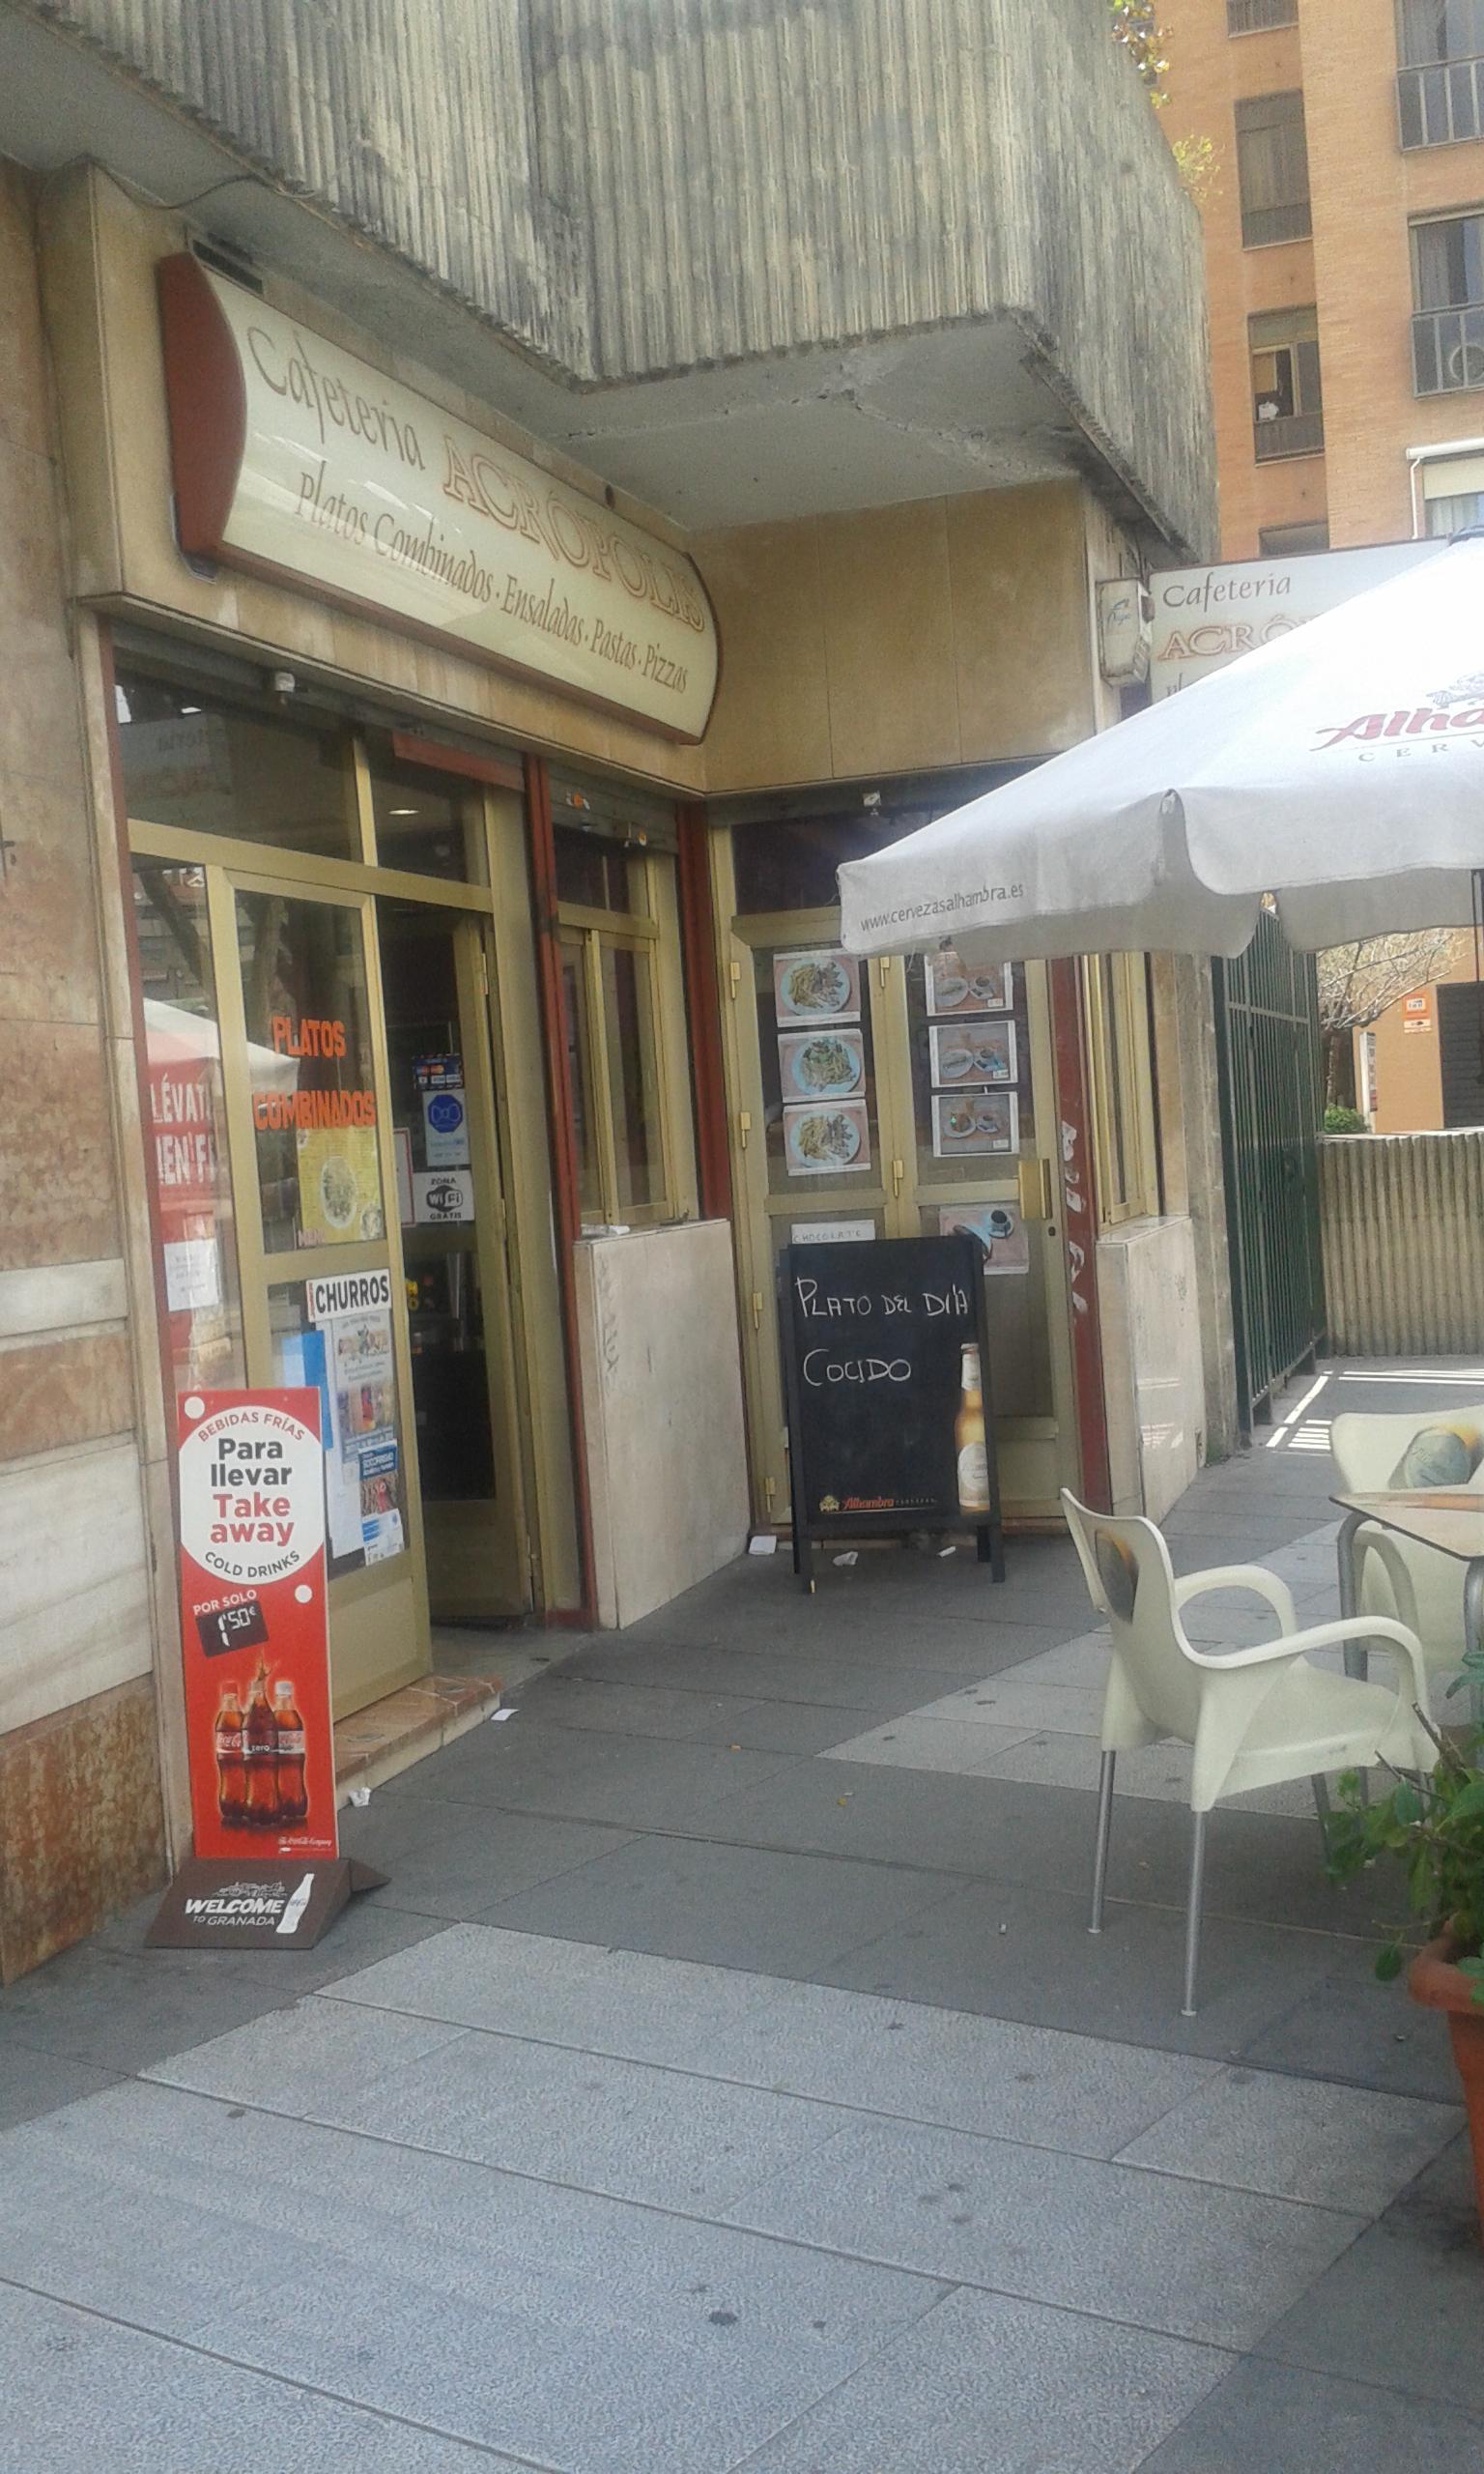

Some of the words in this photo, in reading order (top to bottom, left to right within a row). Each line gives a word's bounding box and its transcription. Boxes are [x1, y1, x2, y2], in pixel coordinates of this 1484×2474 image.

[295, 460, 369, 546] Platos
[374, 512, 495, 603] Combinados
[500, 574, 585, 646] Ensaladas
[590, 618, 638, 671] Pastas
[642, 643, 688, 694] Pizzas
[1157, 613, 1314, 661] ACRÓ
[860, 883, 1024, 932] www.cervezasalhambra.es
[272, 1016, 347, 1058] PLATOS
[253, 1089, 378, 1130] COMBINADOS
[316, 1275, 389, 1314] CHURROS
[795, 1276, 871, 1317] PLATO
[197, 1412, 260, 1442] BEBIDAS
[263, 1414, 305, 1441] FRÍAS
[218, 1438, 283, 1460] Para
[211, 1463, 293, 1487] llevar
[213, 1491, 291, 1518] Take
[210, 1522, 295, 1547] away
[205, 1551, 243, 1577] COLD
[247, 1550, 300, 1578] DRINKS
[192, 1599, 219, 1616] POR
[222, 1589, 257, 1607] SOLO
[185, 1897, 286, 1914] WELCOME
[207, 1915, 275, 1926] GRANADA
